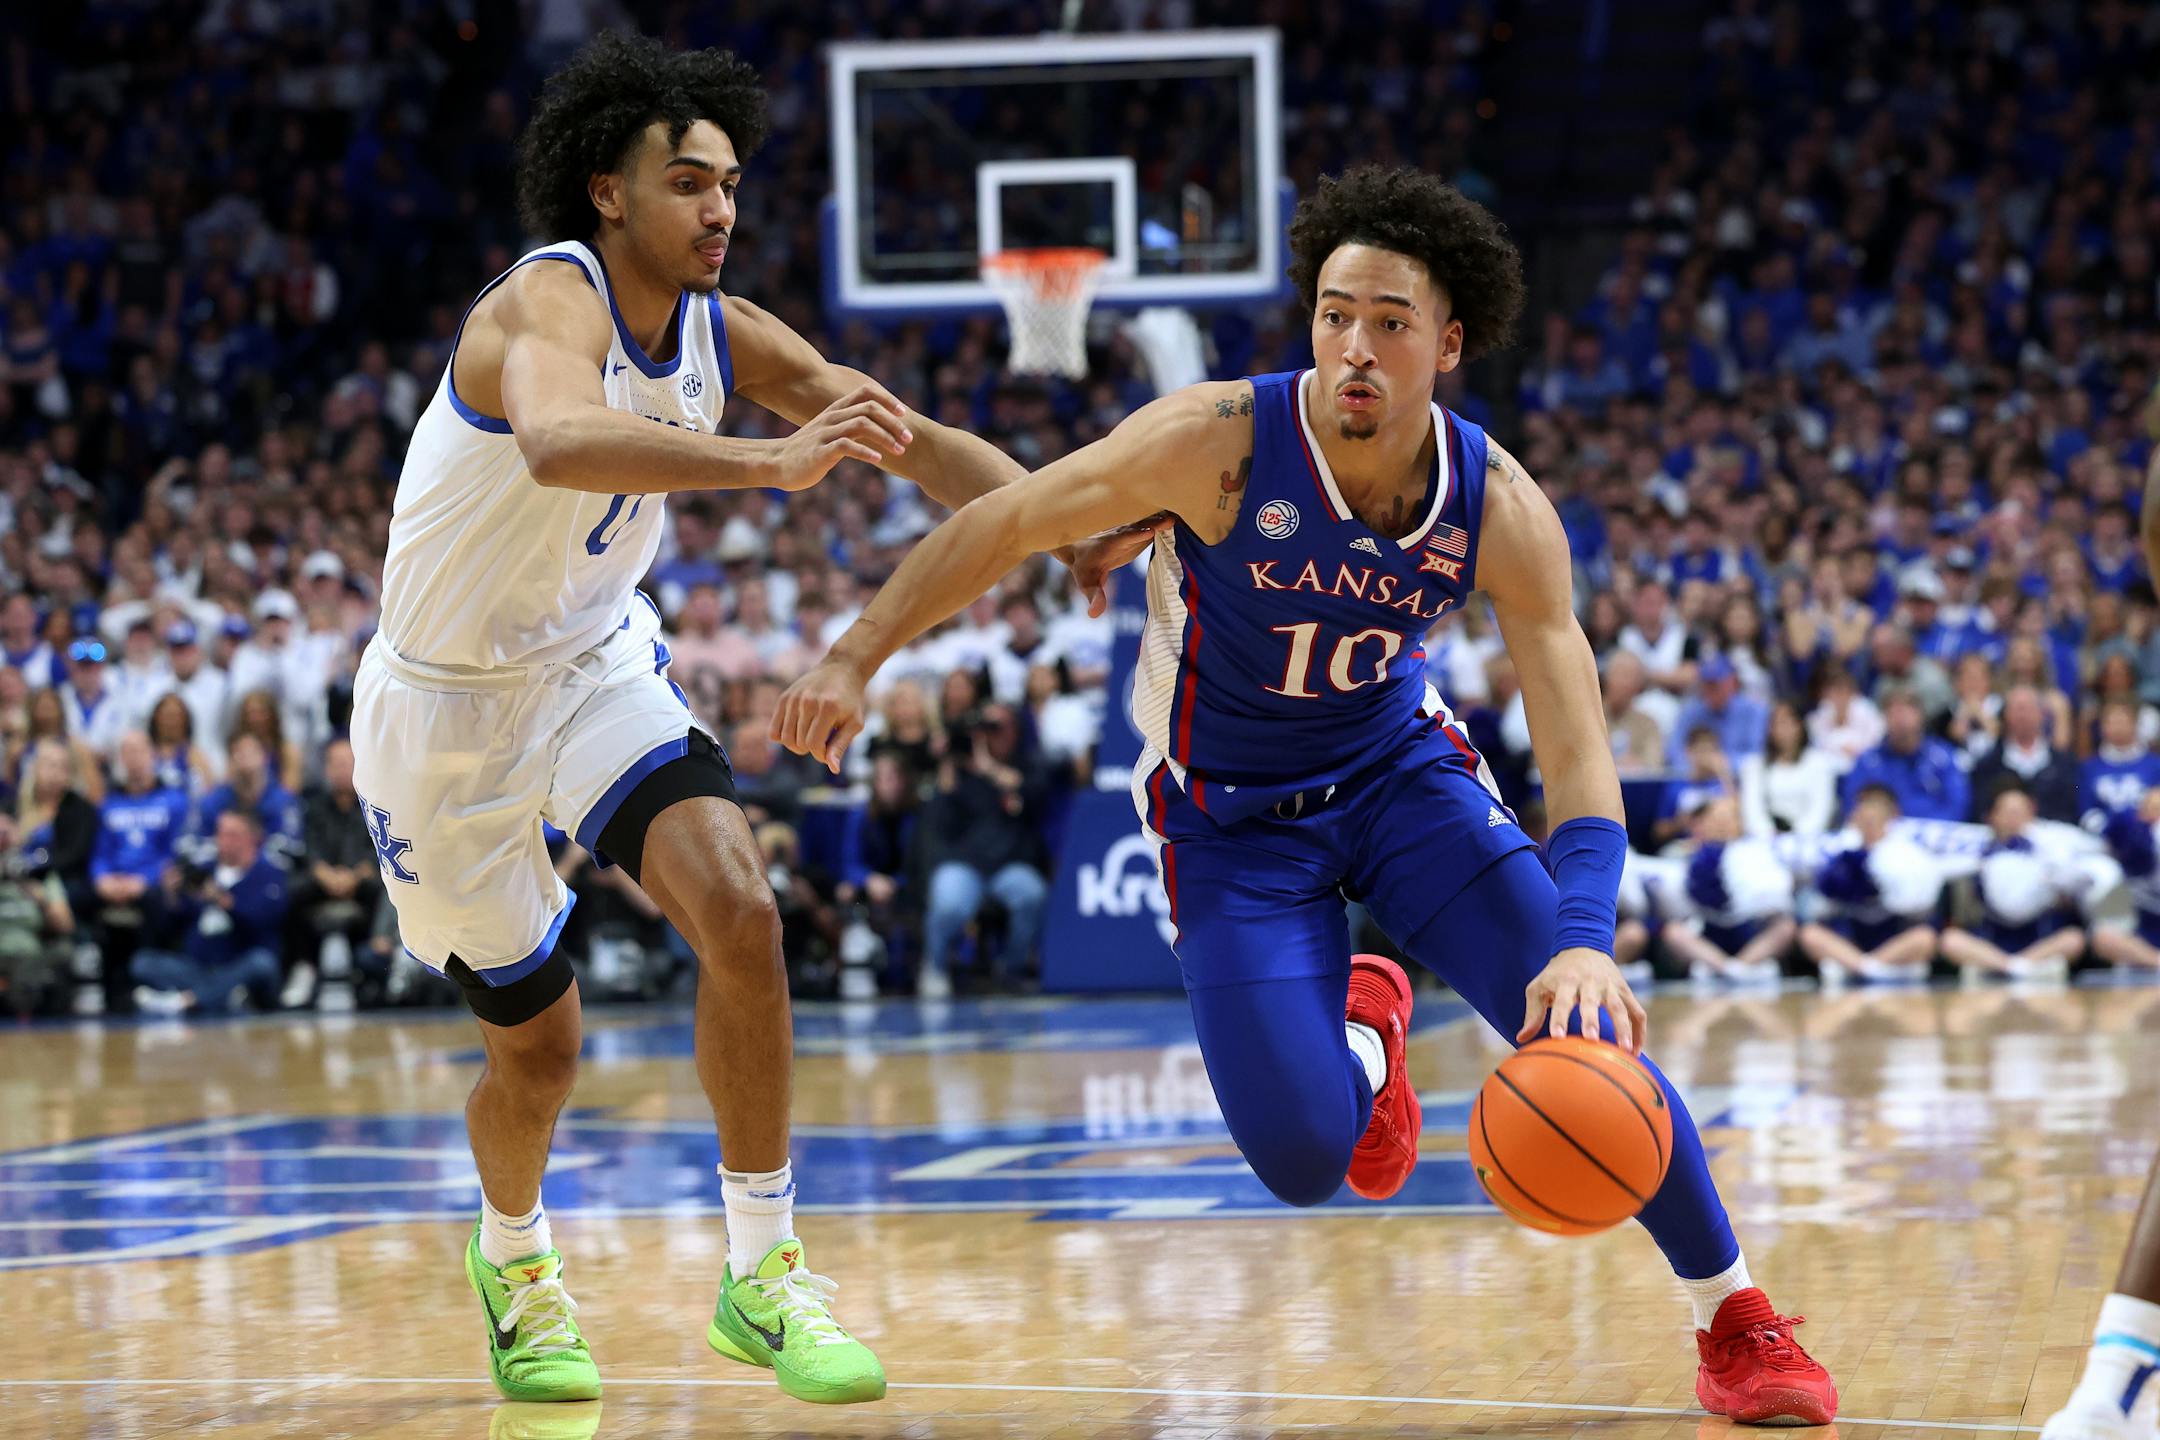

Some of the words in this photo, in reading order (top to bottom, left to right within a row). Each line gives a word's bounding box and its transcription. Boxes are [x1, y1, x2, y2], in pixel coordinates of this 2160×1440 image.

[683, 374, 702, 397] SEC
[1262, 511, 1281, 526] 125
[1349, 541, 1383, 558] adidas
[1418, 551, 1464, 581] XII
[1248, 559, 1455, 619] KANSAS
[1263, 621, 1403, 699] 10
